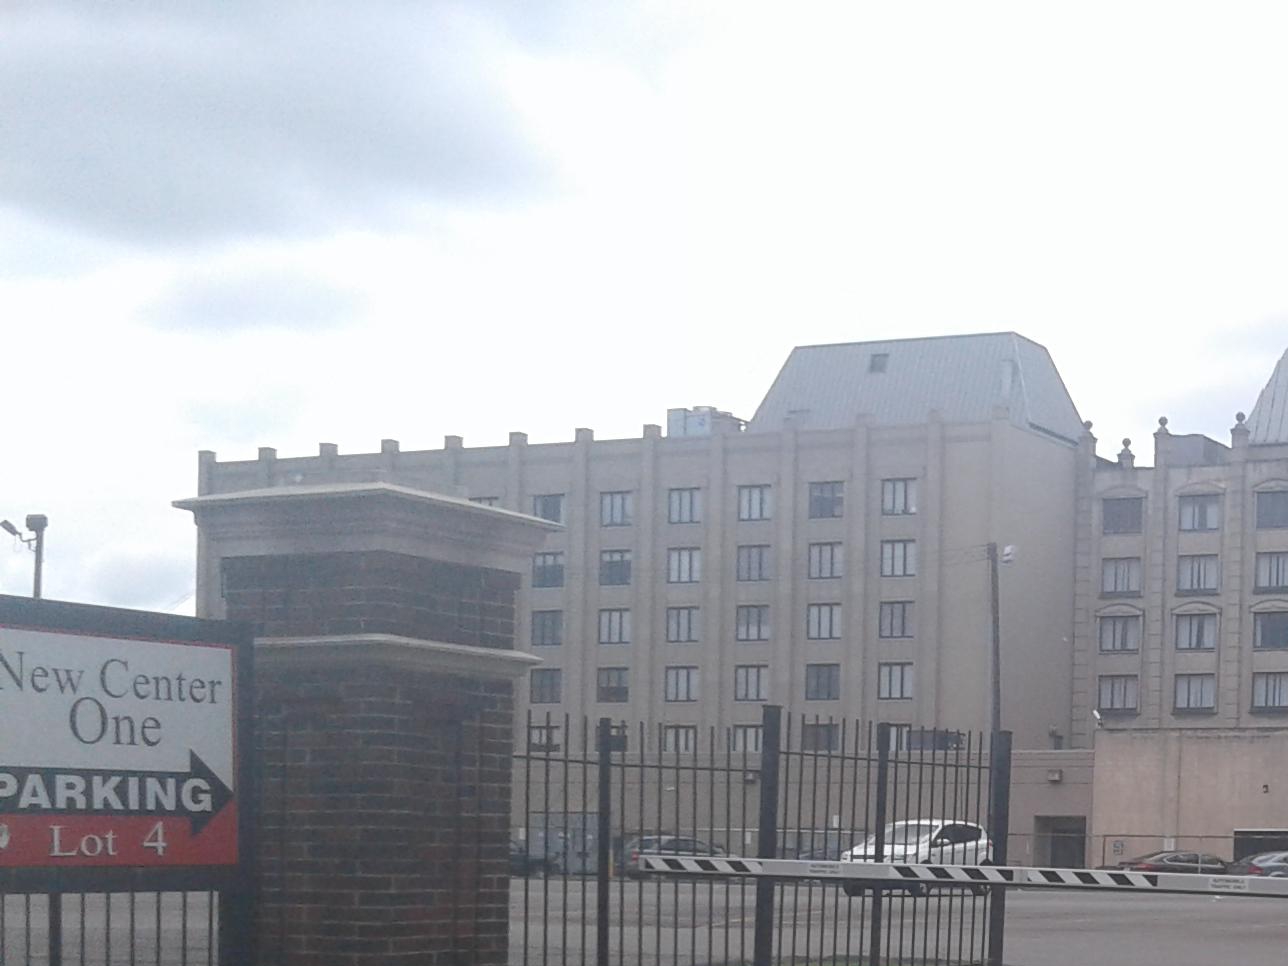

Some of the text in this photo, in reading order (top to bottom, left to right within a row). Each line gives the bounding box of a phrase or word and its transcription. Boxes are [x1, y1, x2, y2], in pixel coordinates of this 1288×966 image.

[0, 651, 222, 704] New Center
[69, 696, 162, 747] One
[0, 773, 213, 812] PARKING
[49, 825, 118, 857] Lot
[143, 820, 168, 856] 4
